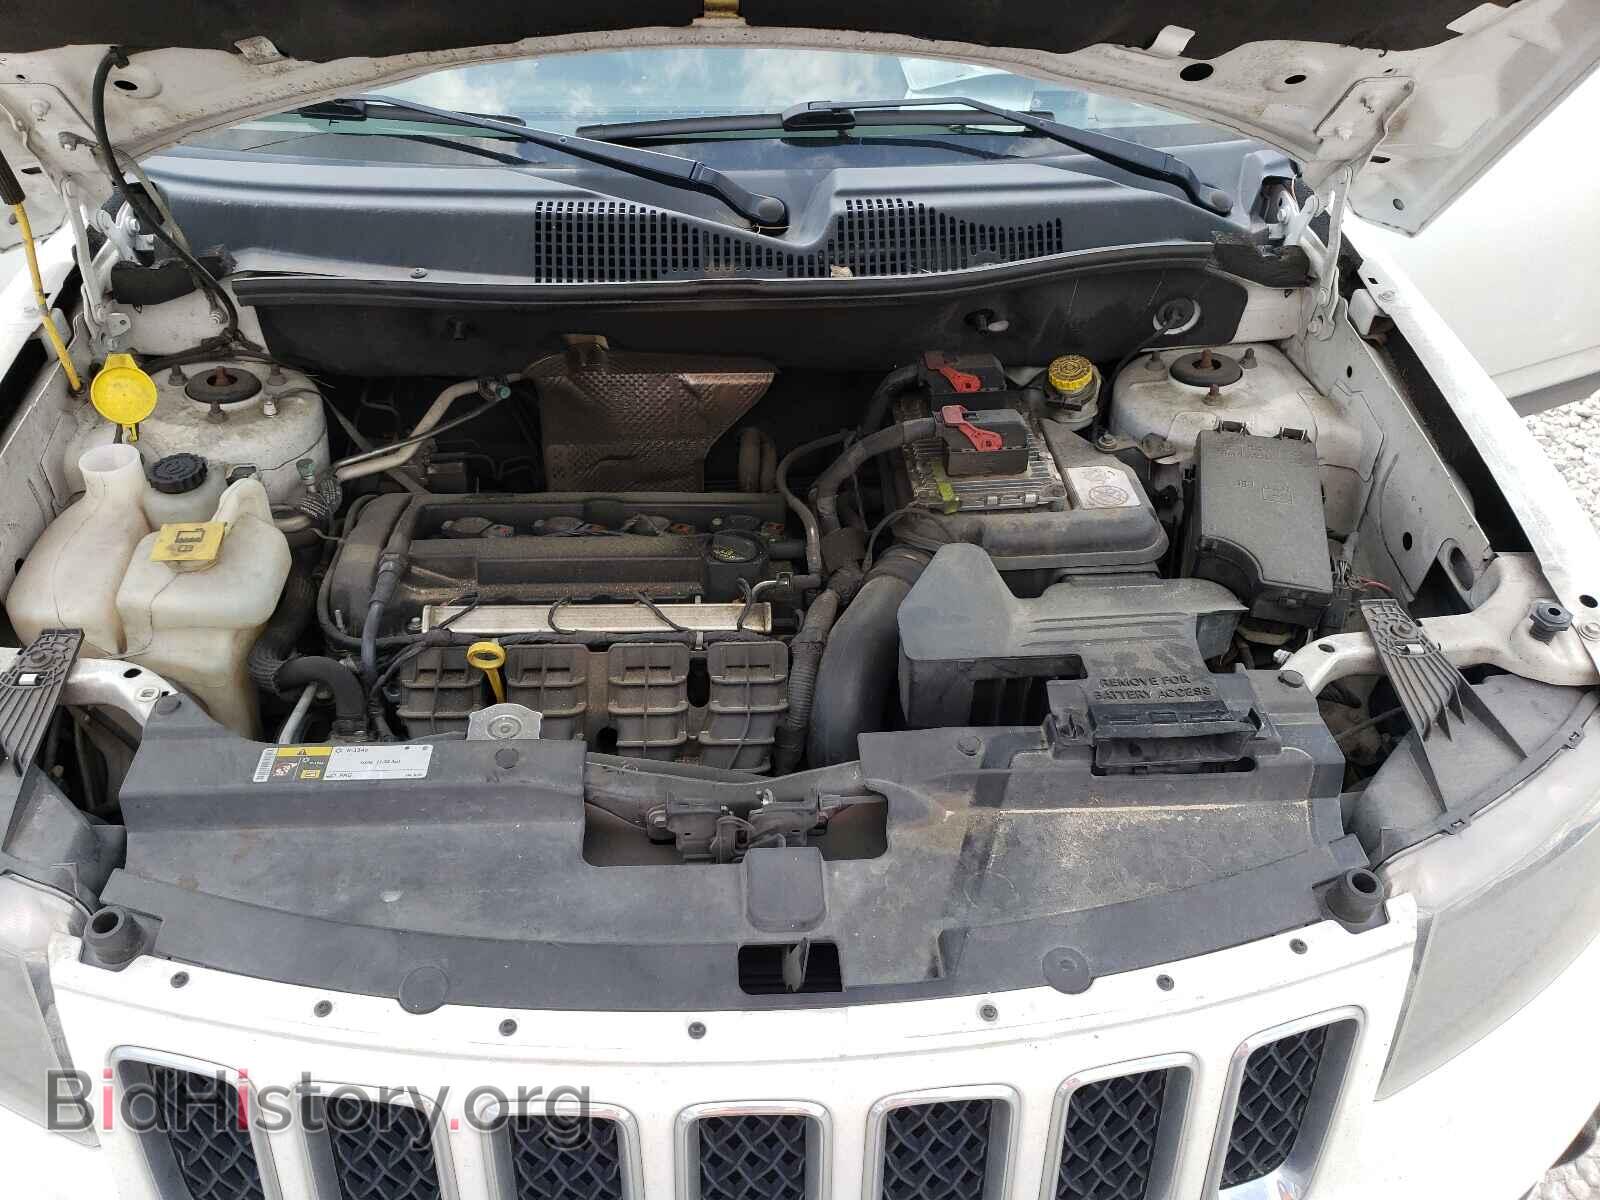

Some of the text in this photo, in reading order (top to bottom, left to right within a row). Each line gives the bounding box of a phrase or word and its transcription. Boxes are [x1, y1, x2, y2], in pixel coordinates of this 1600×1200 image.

[1100, 674, 1193, 687] REMOVE FOR
[1093, 686, 1212, 700] BATTERY ACCESS
